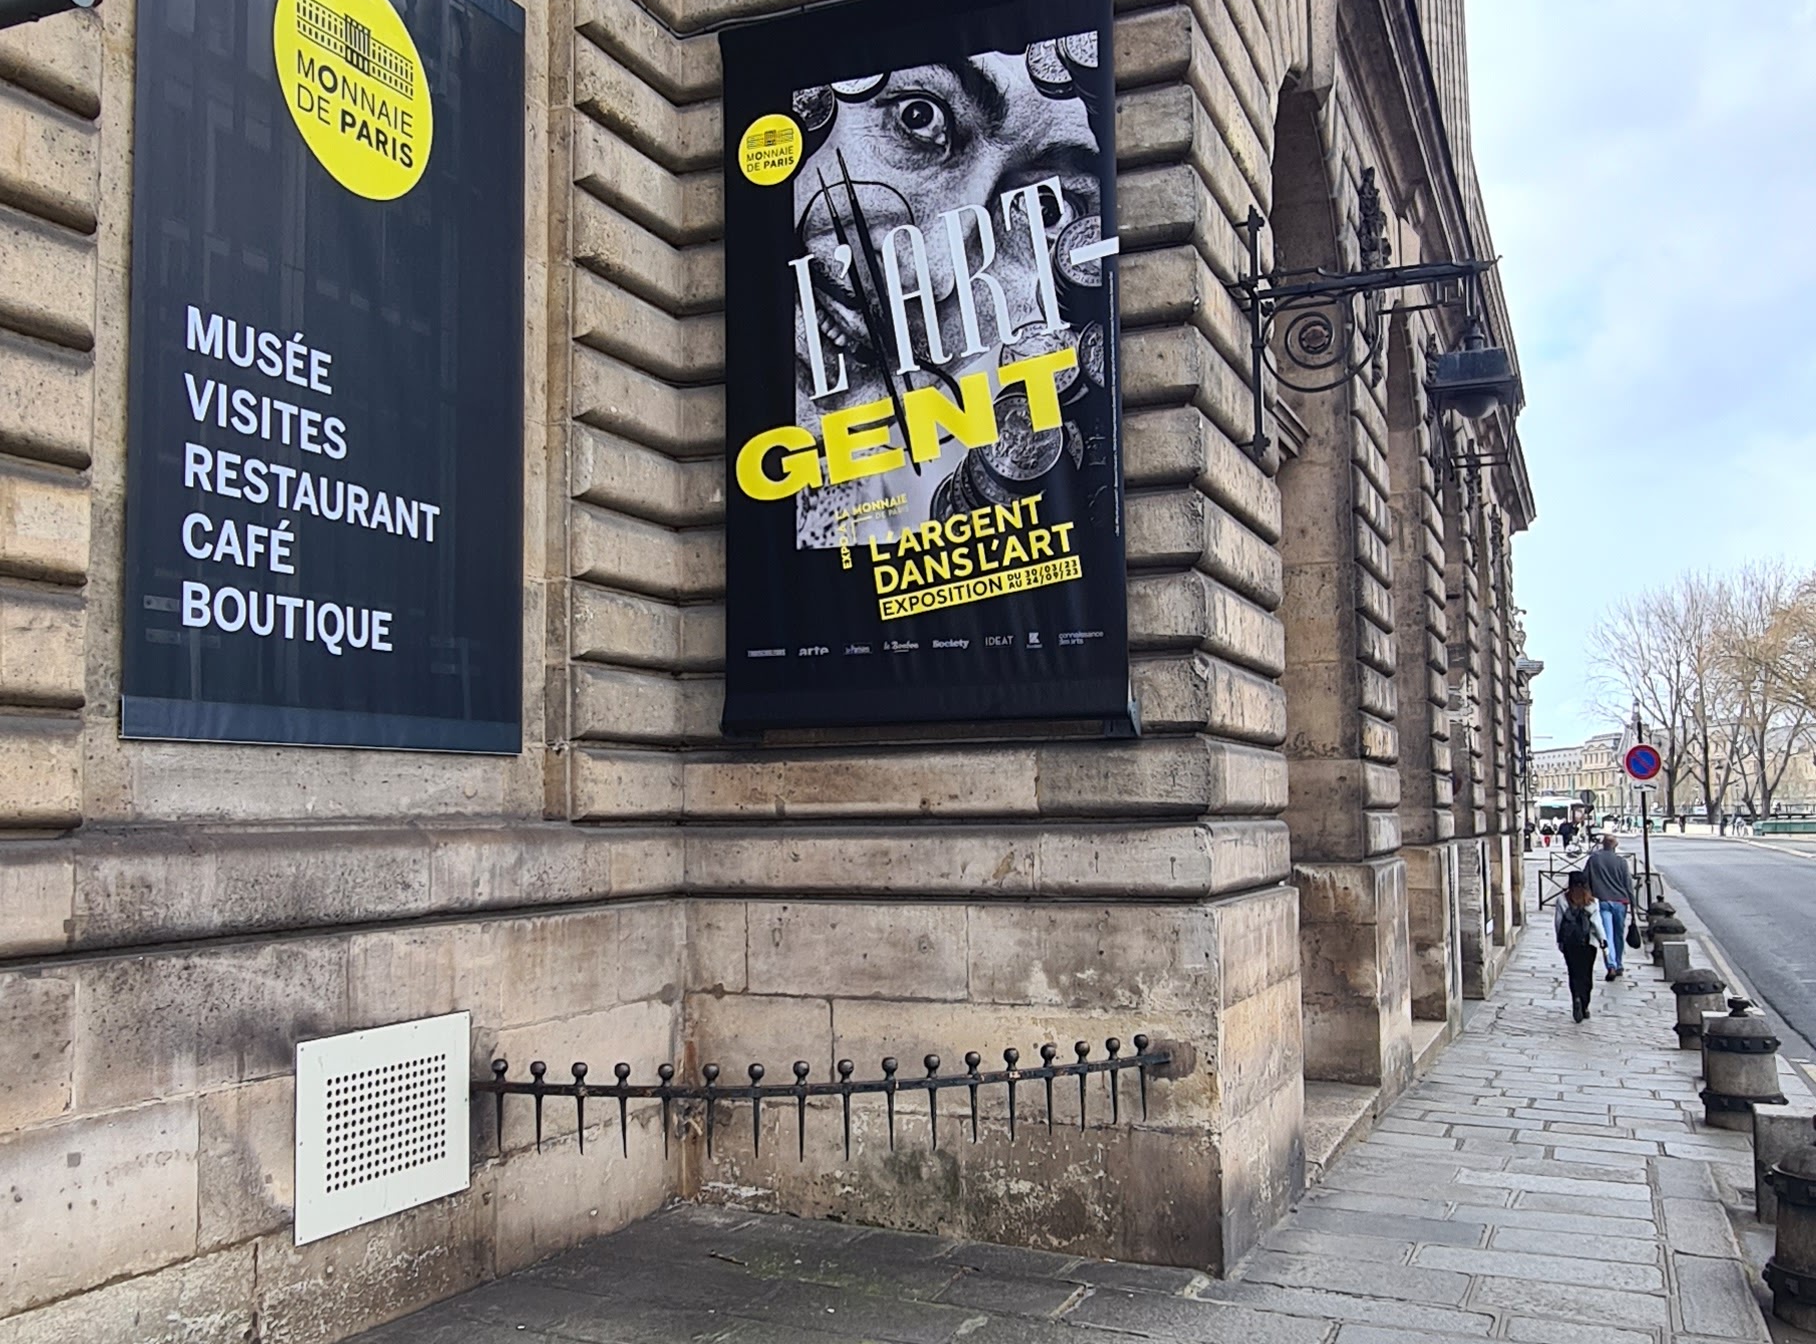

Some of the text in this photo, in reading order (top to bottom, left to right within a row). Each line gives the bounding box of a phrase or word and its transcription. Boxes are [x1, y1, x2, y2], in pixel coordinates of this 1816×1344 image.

[297, 49, 413, 139] MONNAIE
[297, 83, 413, 169] DE PARIS
[746, 145, 794, 162] MONNAIE
[747, 156, 795, 173] DE PARIS
[186, 305, 332, 395] MUSÉE
[184, 372, 347, 460] VISITES
[735, 347, 1078, 501] GENT
[184, 442, 440, 542] RESTAURANT
[835, 492, 907, 521] LA MONNAIE
[182, 512, 295, 574] CAFÉ
[840, 536, 853, 570] EXPO
[873, 547, 974, 594] DANS
[1007, 572, 1021, 582] DU
[1009, 580, 1022, 589] AU
[882, 576, 1003, 616] EXPOSITION
[182, 580, 393, 655] BOUTIQUE
[799, 646, 829, 656] arte
[932, 638, 969, 649] Society
[985, 635, 1014, 646] IDEAT
